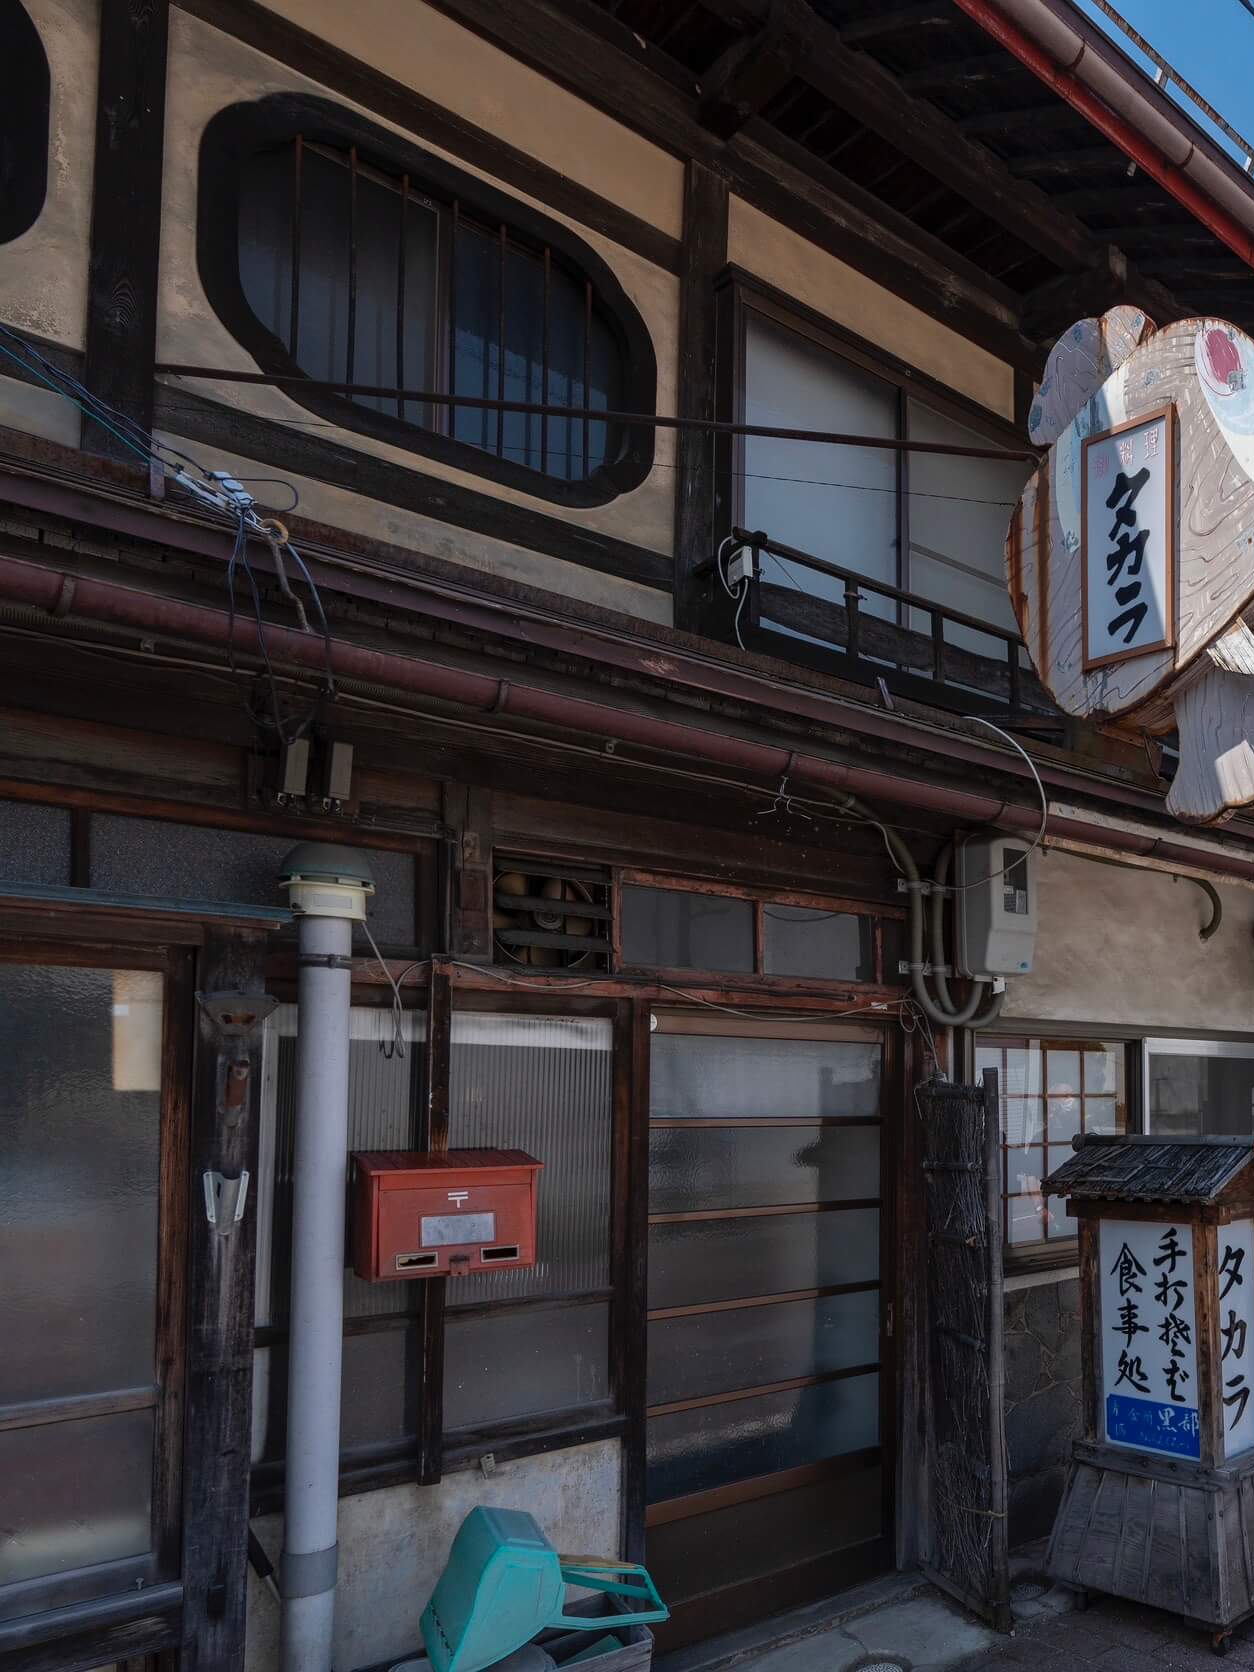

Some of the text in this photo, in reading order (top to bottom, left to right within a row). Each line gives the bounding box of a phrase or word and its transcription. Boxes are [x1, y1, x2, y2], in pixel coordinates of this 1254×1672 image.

[1106, 467, 1150, 644] タカラ
[1110, 1242, 1152, 1394] 食事処
[1219, 1245, 1250, 1431] タカラ
